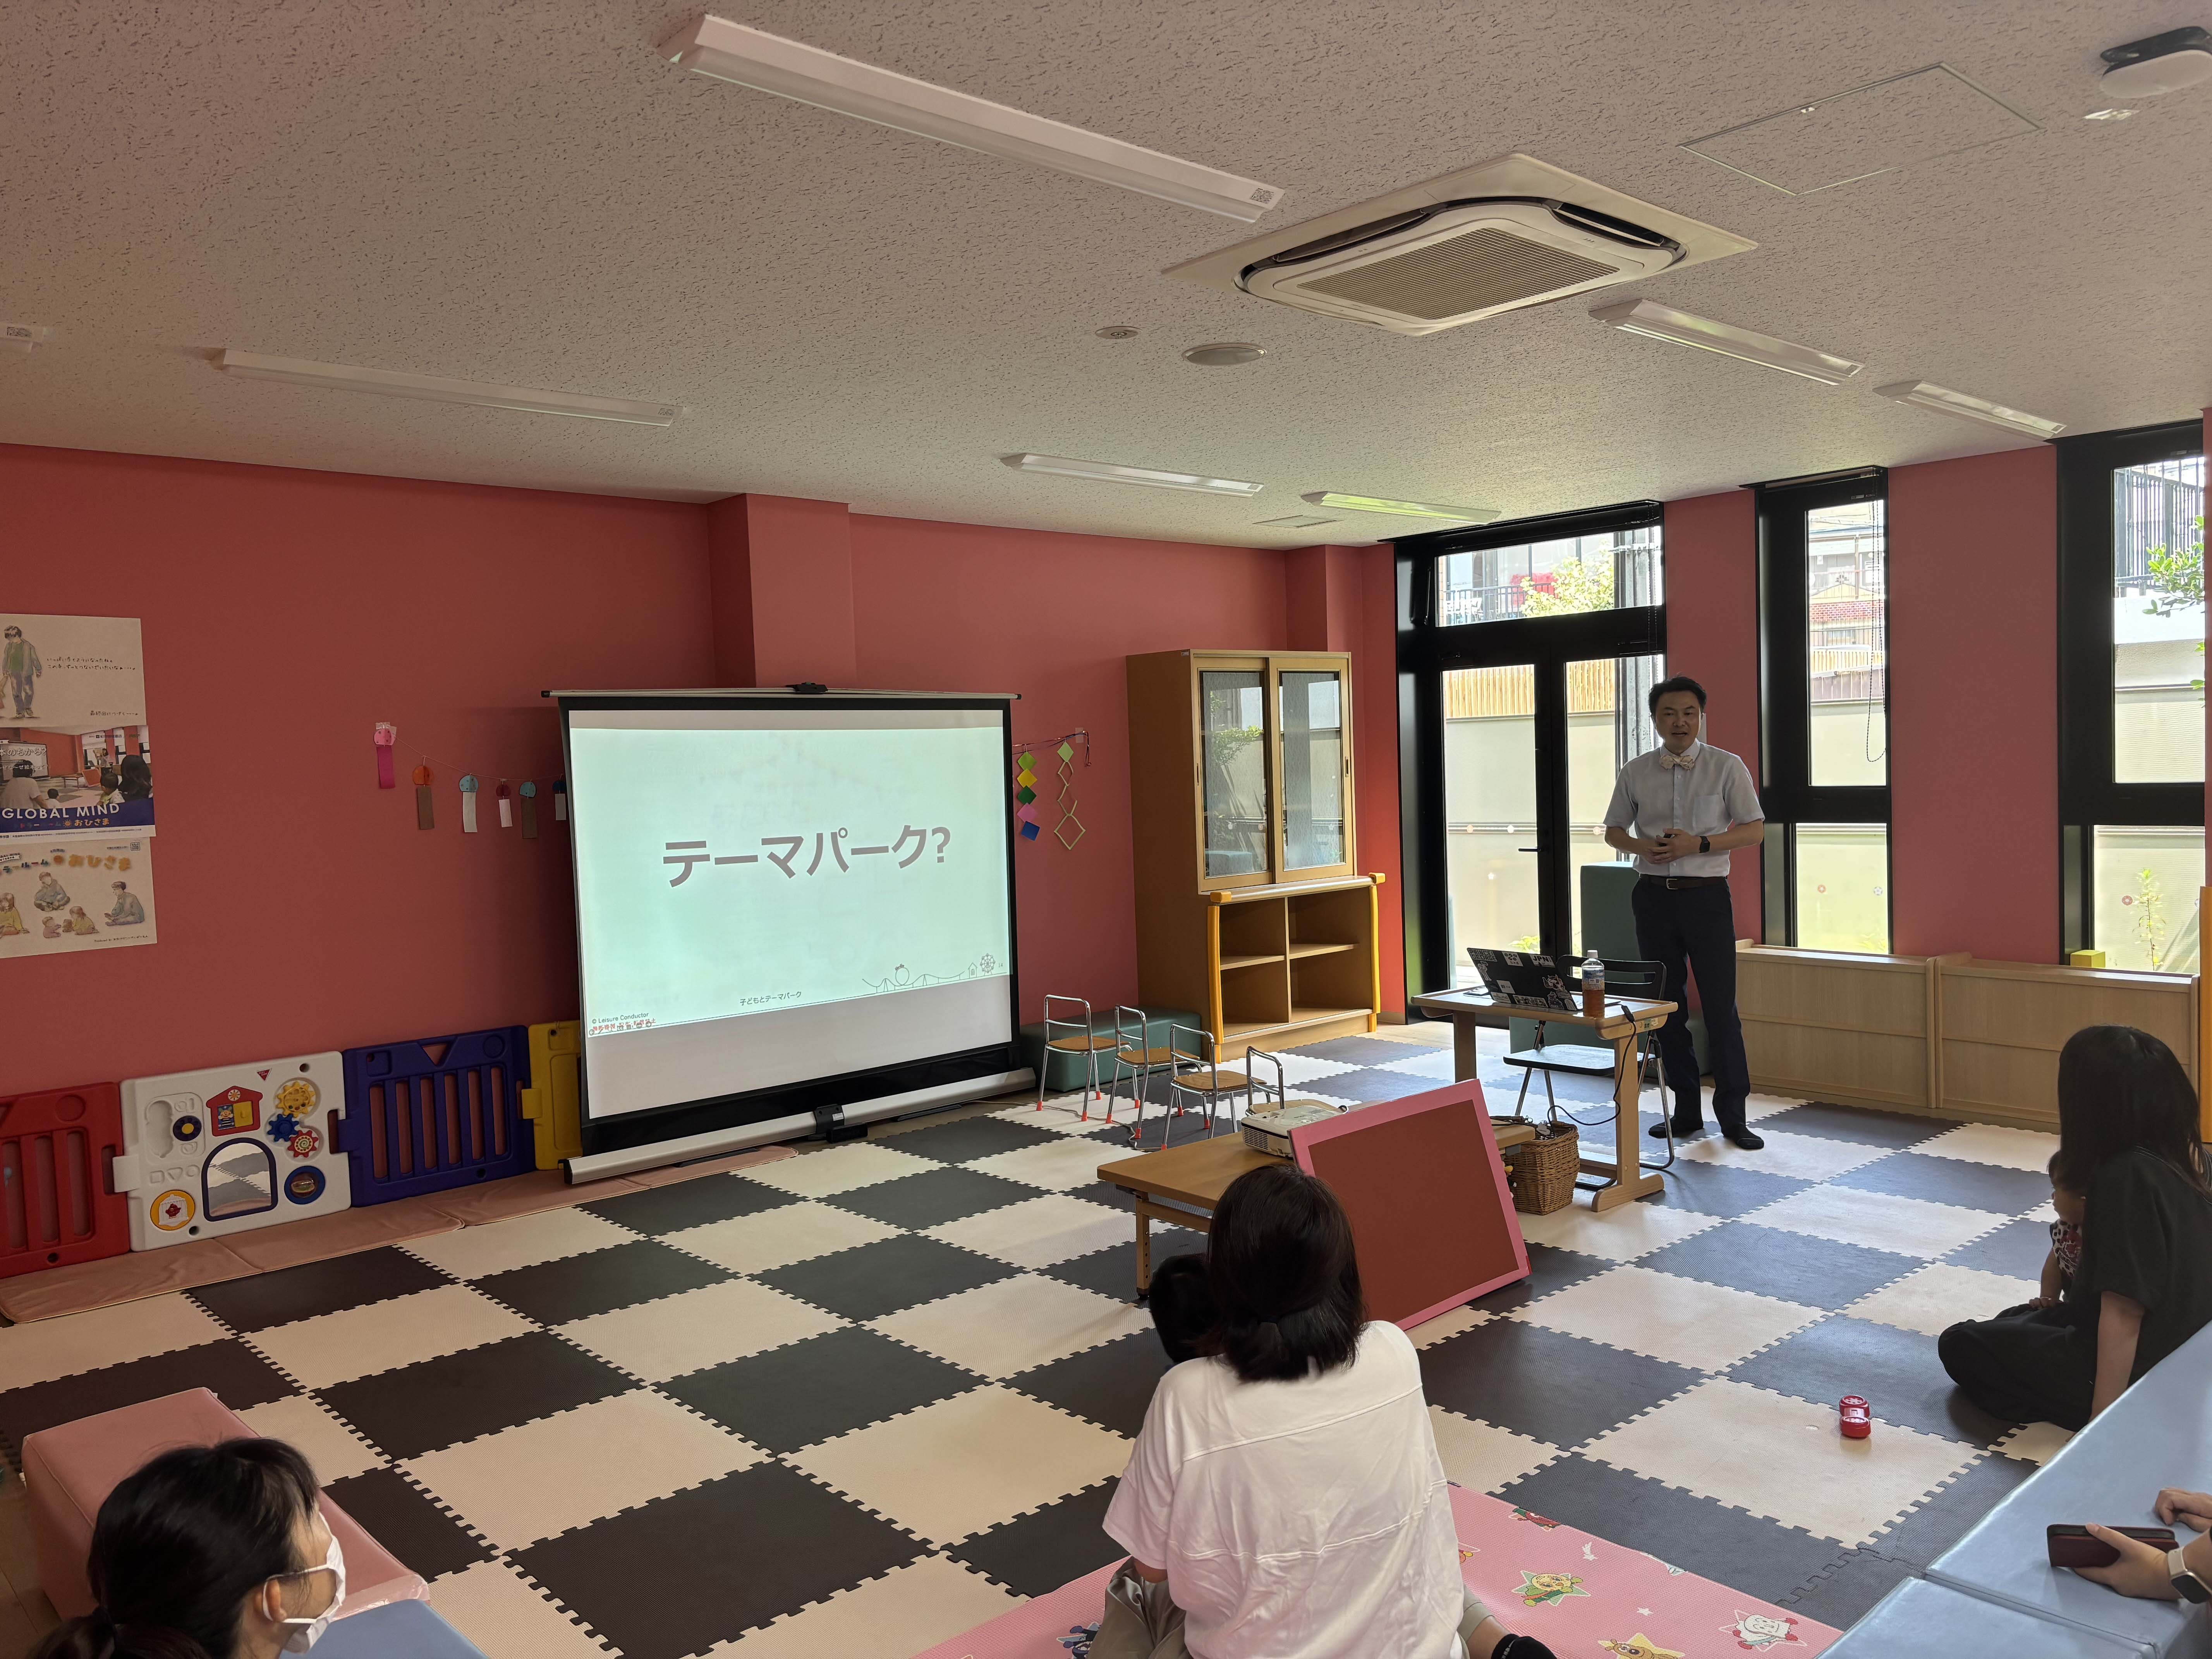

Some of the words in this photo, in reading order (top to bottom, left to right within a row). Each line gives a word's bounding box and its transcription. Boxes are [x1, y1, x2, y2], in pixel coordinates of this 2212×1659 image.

[2, 808, 69, 819] GLOBAL
[77, 804, 119, 817] MIND
[74, 818, 110, 826] おひさま
[663, 825, 951, 888] テーマパーク?
[740, 991, 801, 1006] 子どもとテーマパーク
